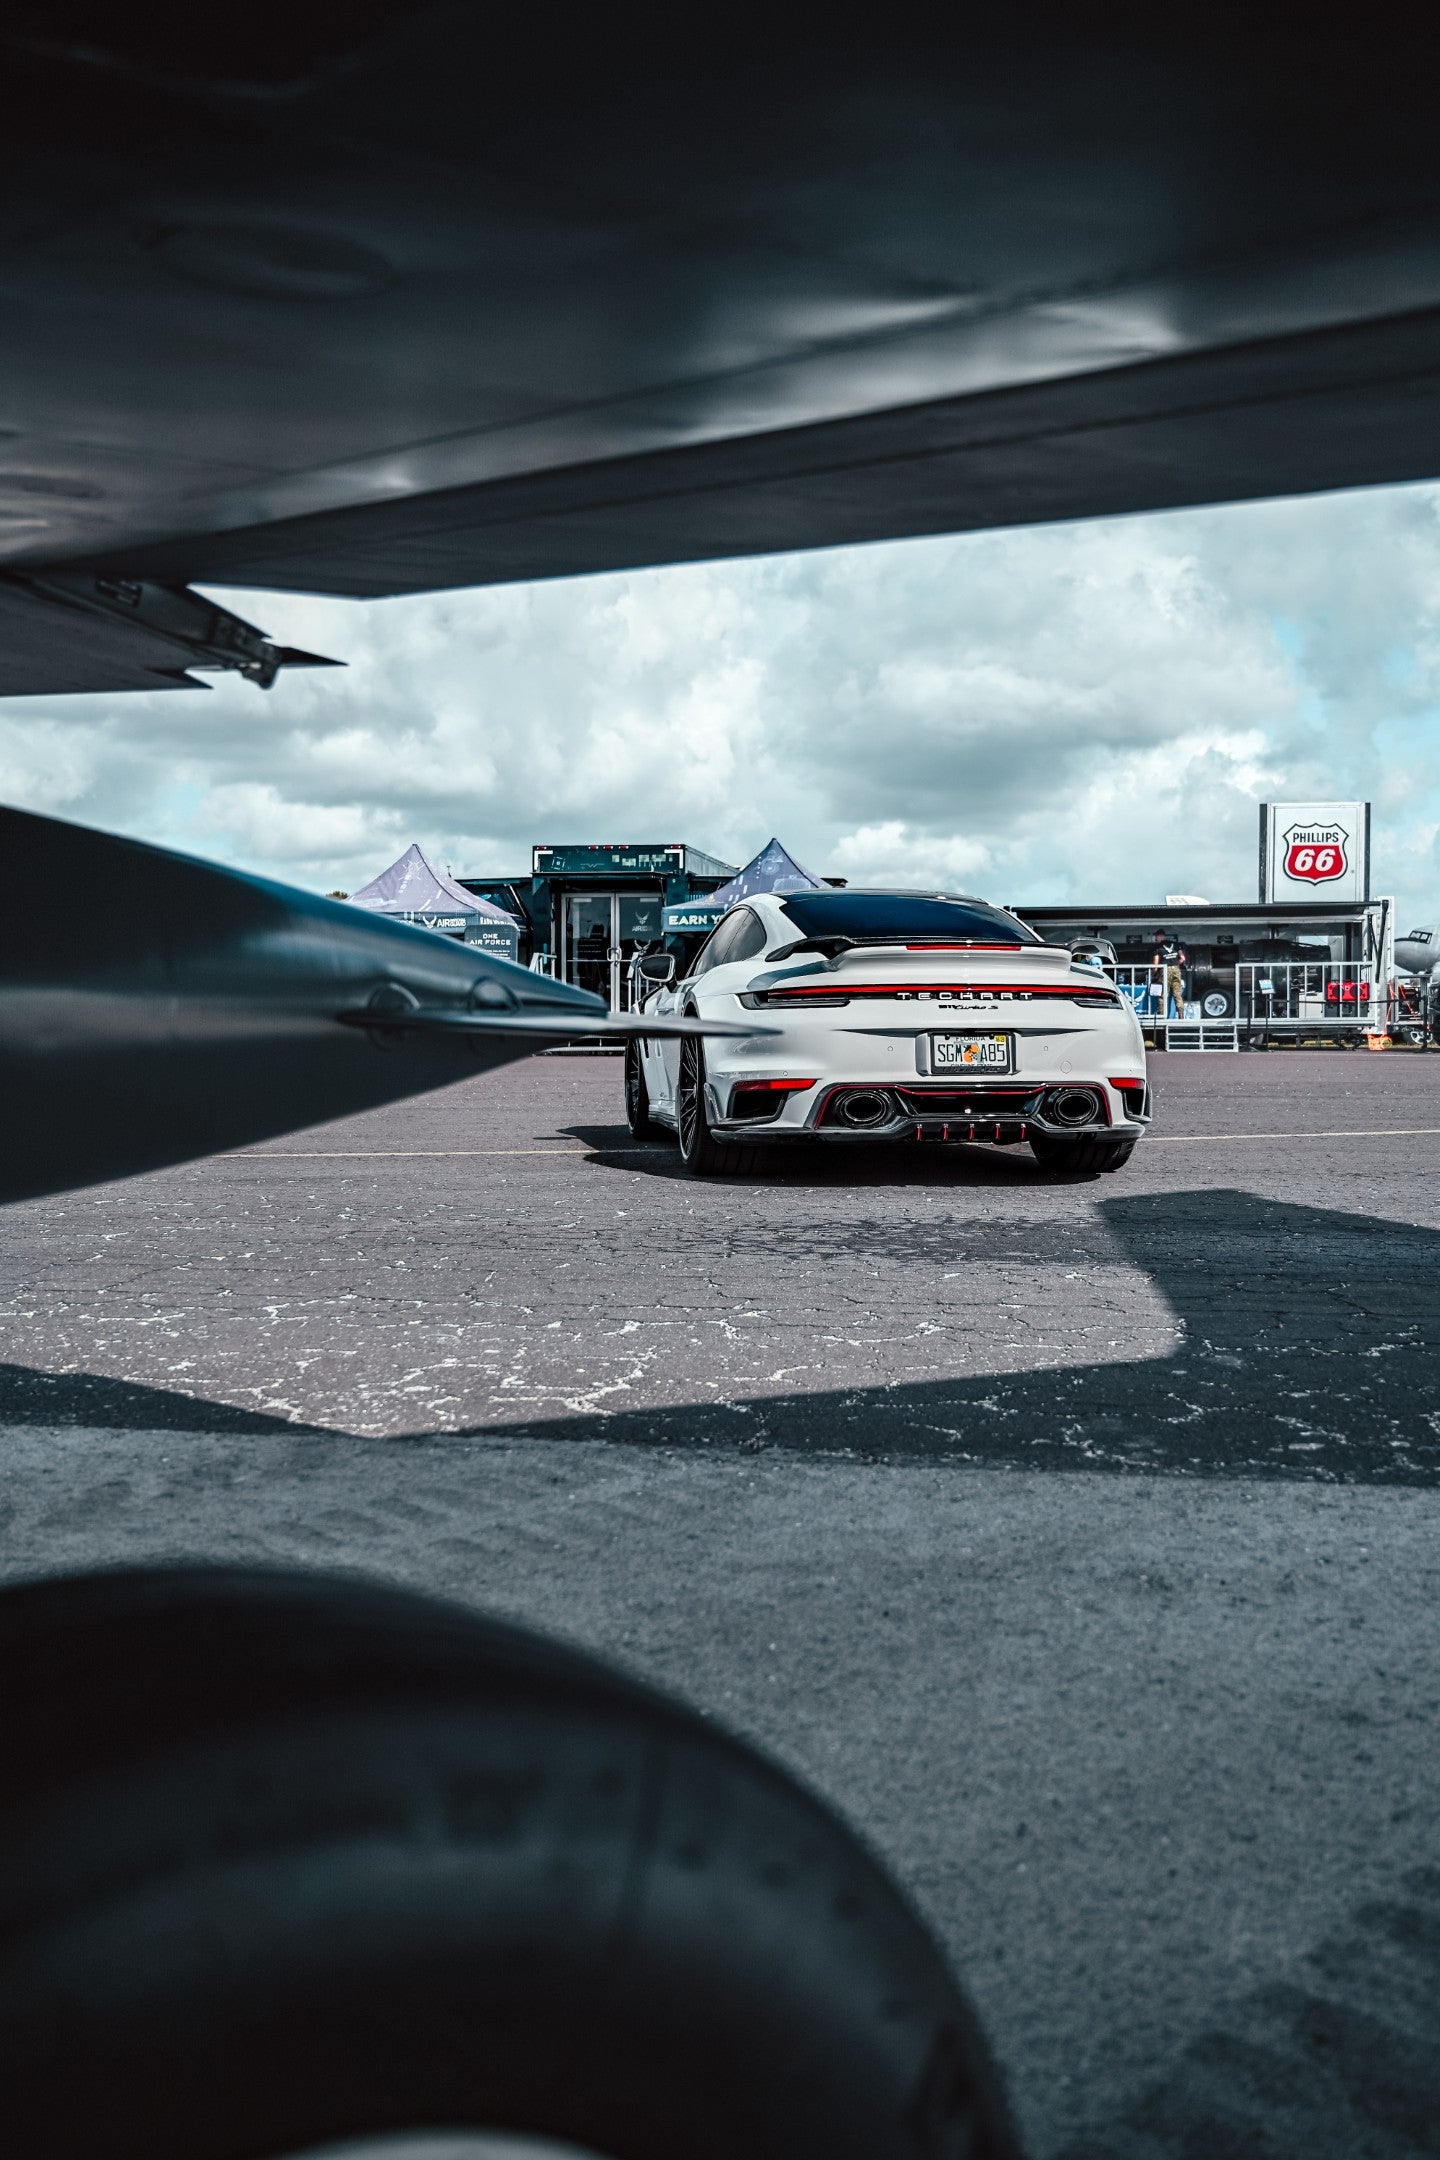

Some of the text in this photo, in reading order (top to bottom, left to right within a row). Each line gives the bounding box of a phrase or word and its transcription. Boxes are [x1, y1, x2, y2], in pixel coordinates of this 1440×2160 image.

[1292, 832, 1340, 843] PHILLIPS
[1294, 848, 1336, 872] 66
[668, 915, 708, 925] EARN
[897, 992, 1033, 1000] TECHART
[937, 1043, 1006, 1063] SGM A85
